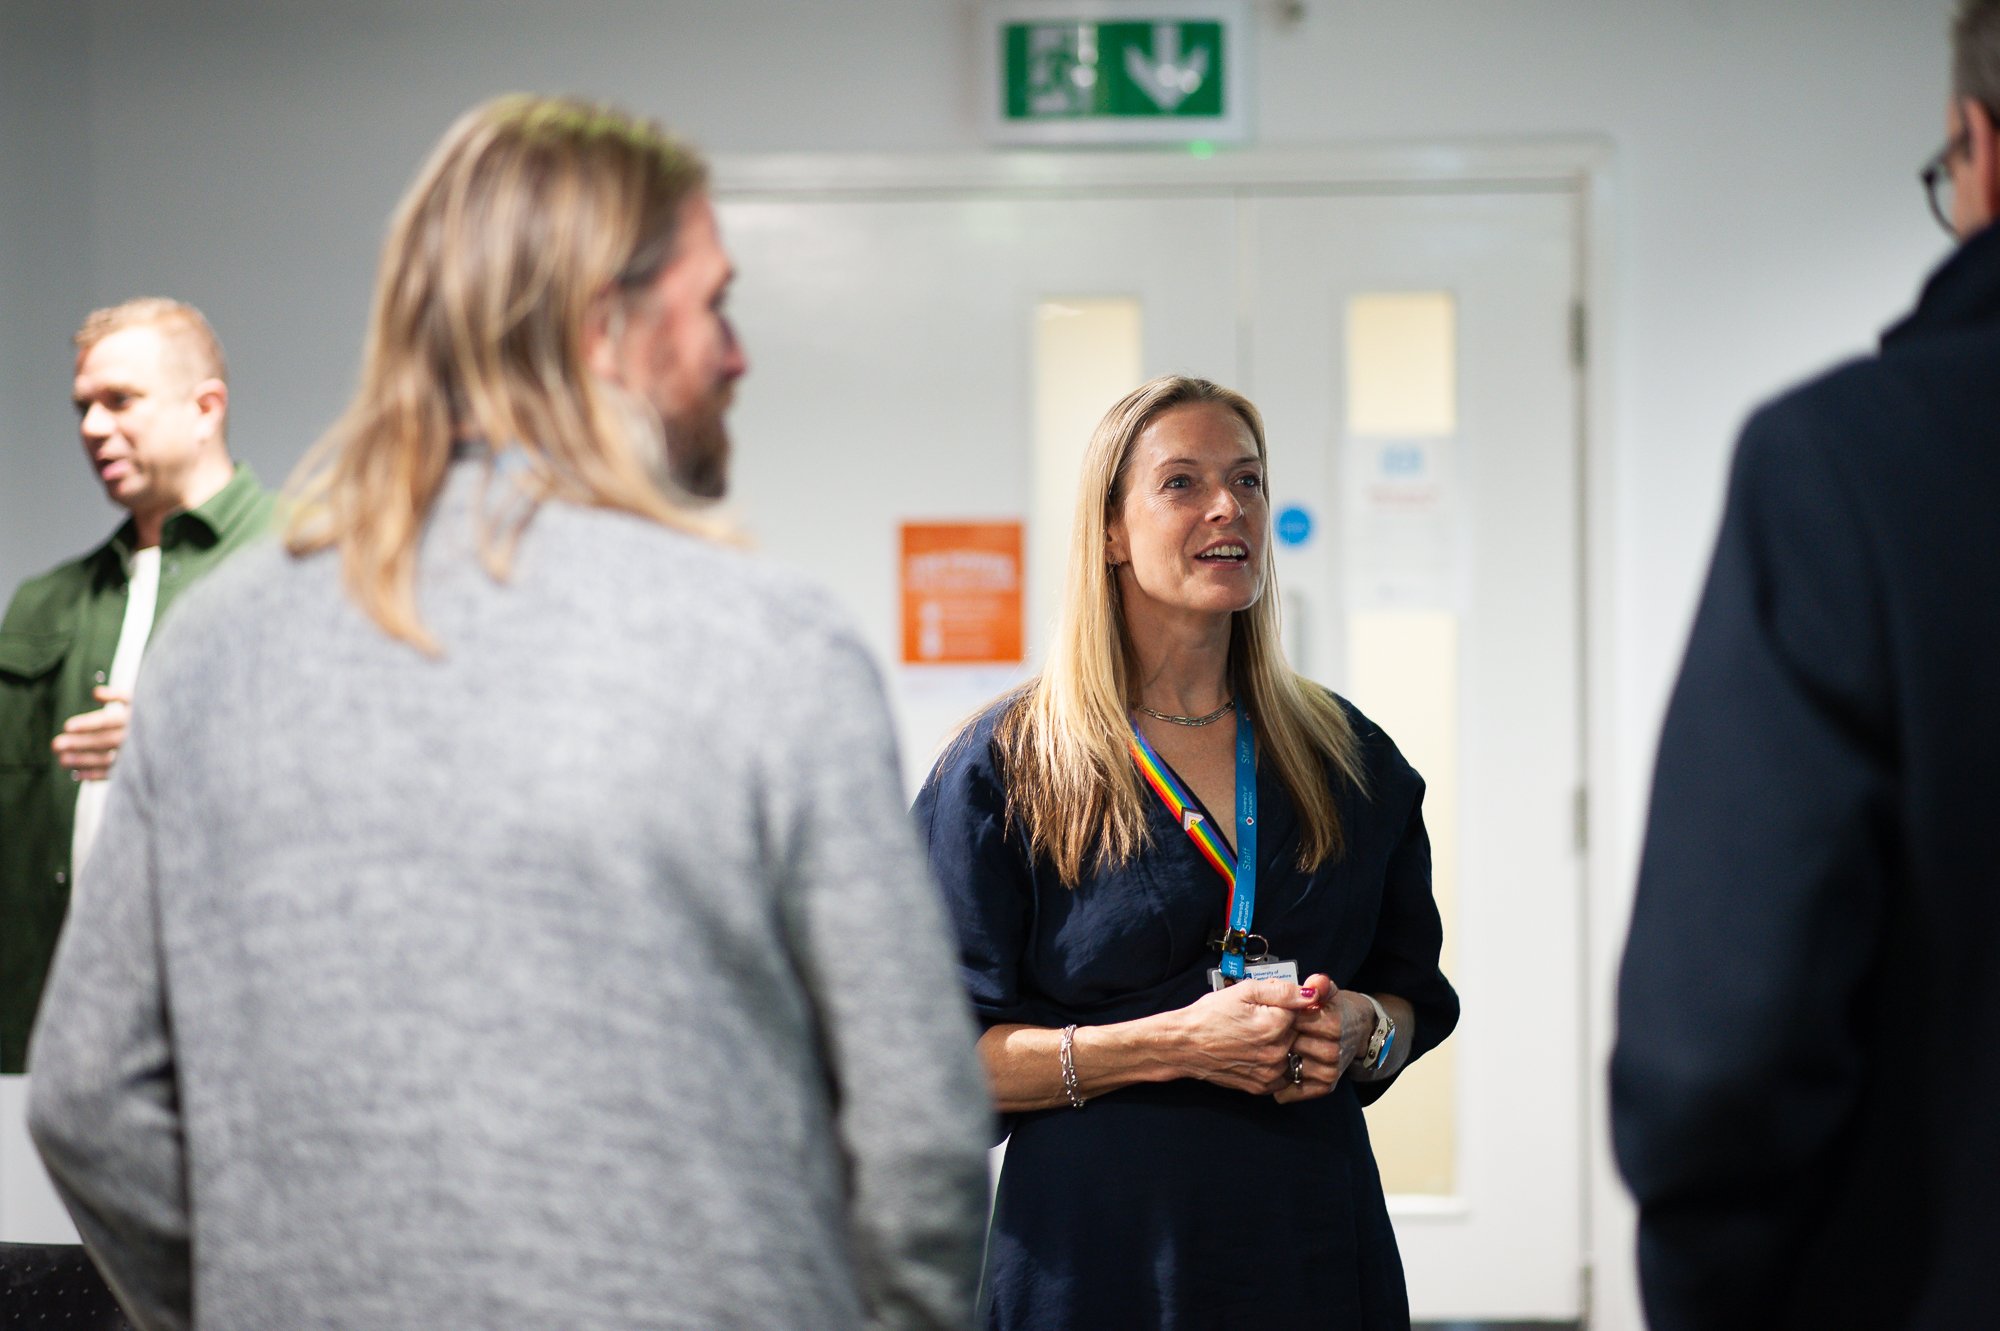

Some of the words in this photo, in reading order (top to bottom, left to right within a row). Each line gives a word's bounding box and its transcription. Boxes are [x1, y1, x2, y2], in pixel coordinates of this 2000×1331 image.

[1241, 740, 1250, 765] Staff
[1242, 846, 1252, 871] Staff
[1236, 901, 1245, 926] University
[1242, 900, 1250, 927] Lancashire
[1228, 960, 1238, 976] aff
